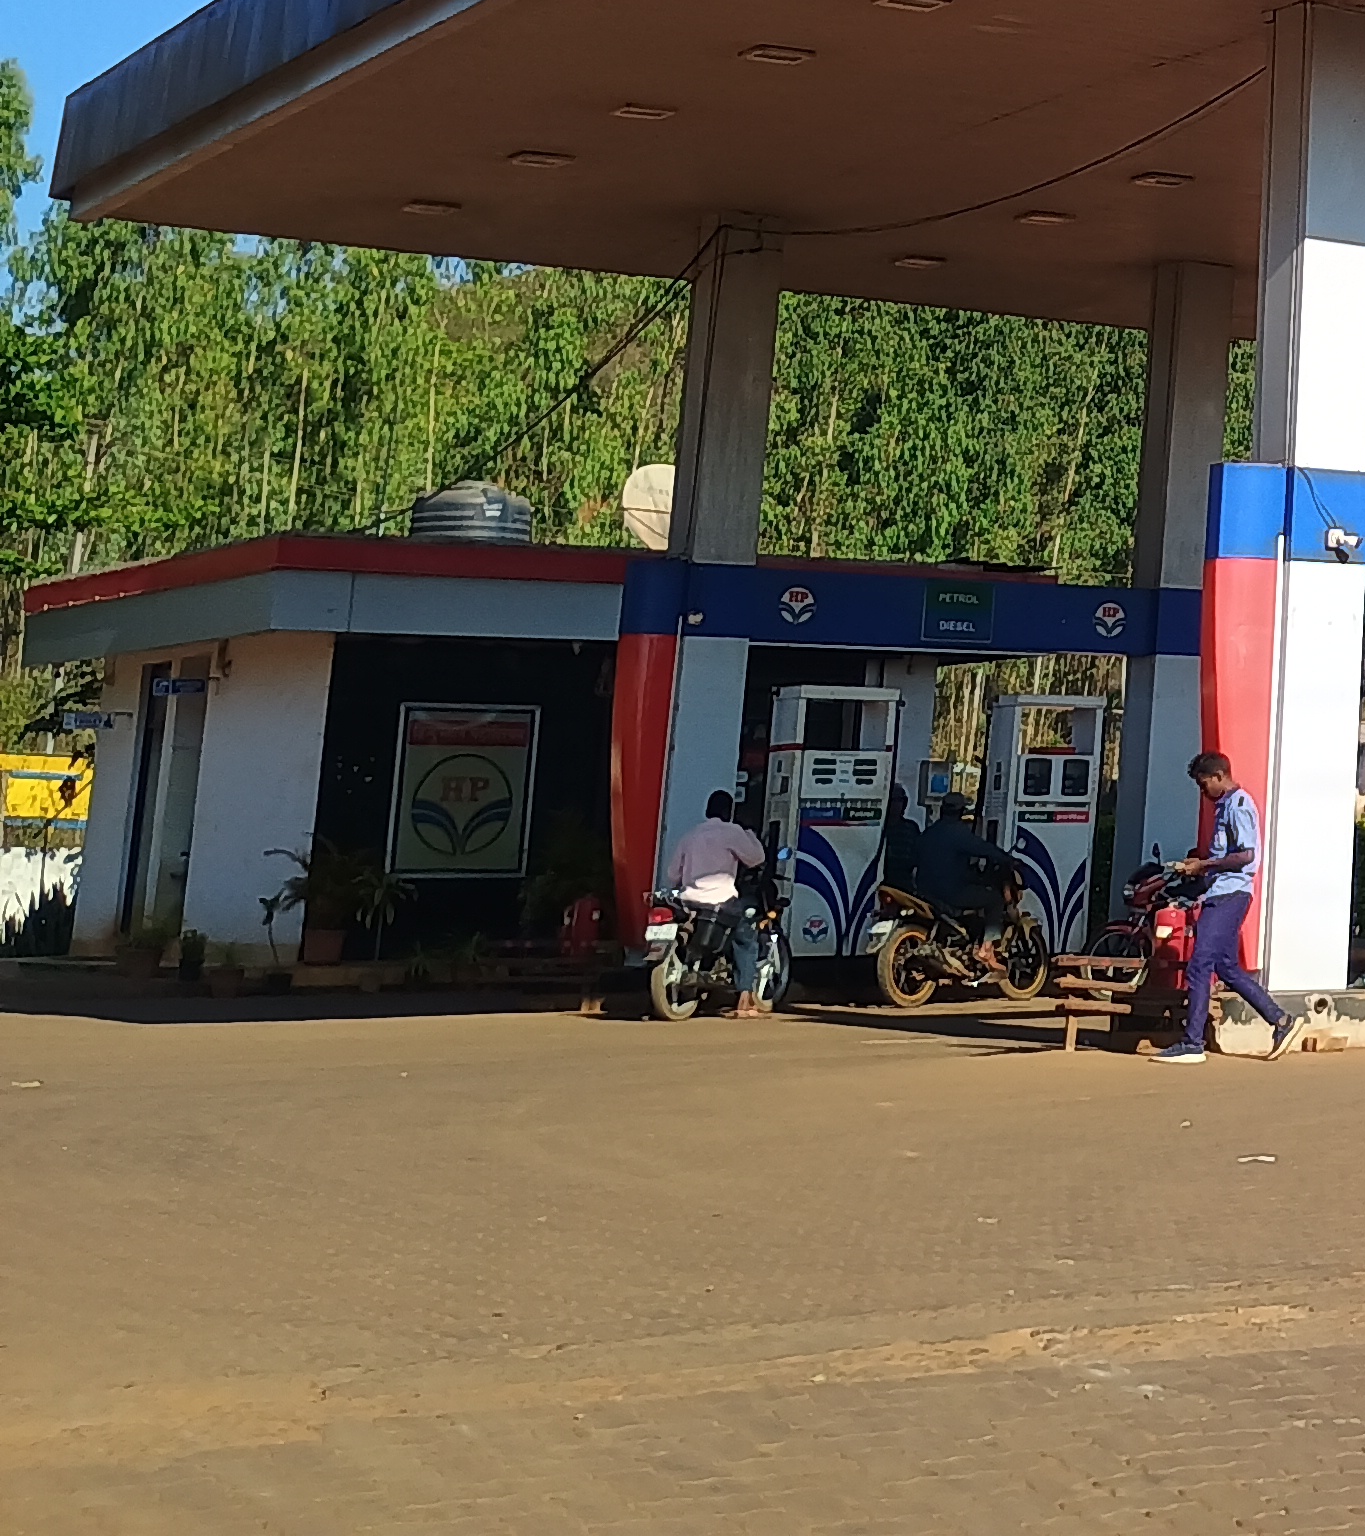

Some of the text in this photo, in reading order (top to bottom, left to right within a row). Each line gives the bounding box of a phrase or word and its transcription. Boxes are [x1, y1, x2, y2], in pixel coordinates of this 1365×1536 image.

[788, 590, 809, 604] HP
[938, 592, 980, 605] PETROL
[1102, 606, 1120, 618] HP
[938, 620, 976, 633] DIESEL
[439, 775, 490, 803] HP
